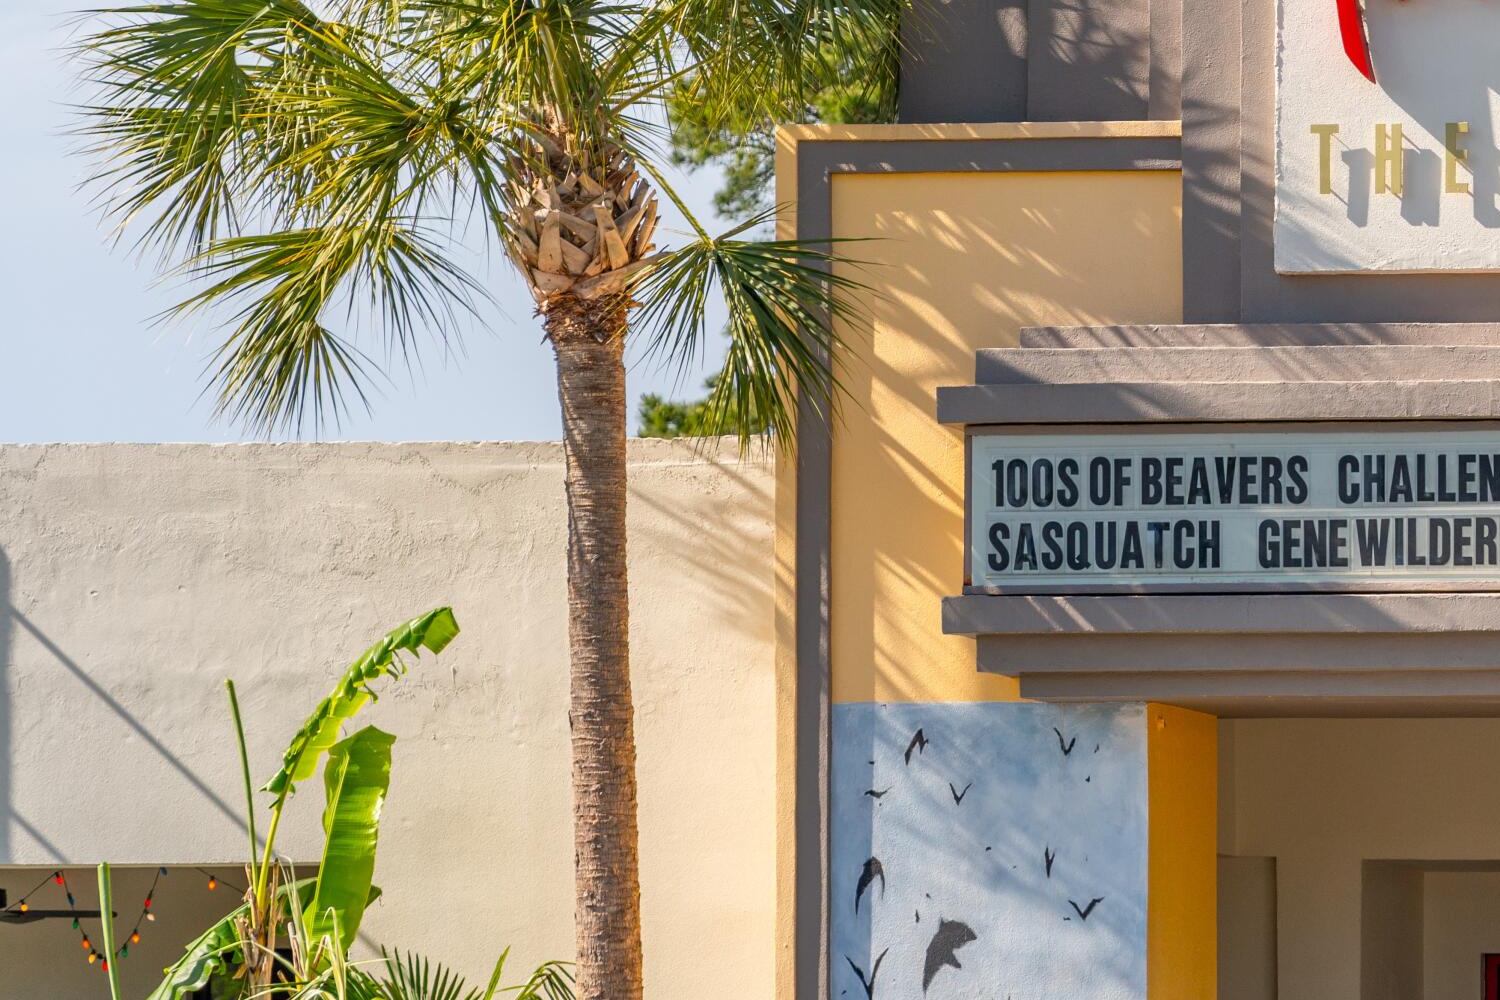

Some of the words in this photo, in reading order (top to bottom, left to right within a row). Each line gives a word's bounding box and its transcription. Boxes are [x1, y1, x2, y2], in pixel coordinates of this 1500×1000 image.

[991, 458, 1079, 508] 100S
[1089, 456, 1132, 506] OF
[1140, 455, 1310, 505] BEAVERS
[988, 519, 1221, 571] SASQUATCH
[1258, 518, 1349, 569] GENE
[1356, 517, 1498, 567] WILDER
